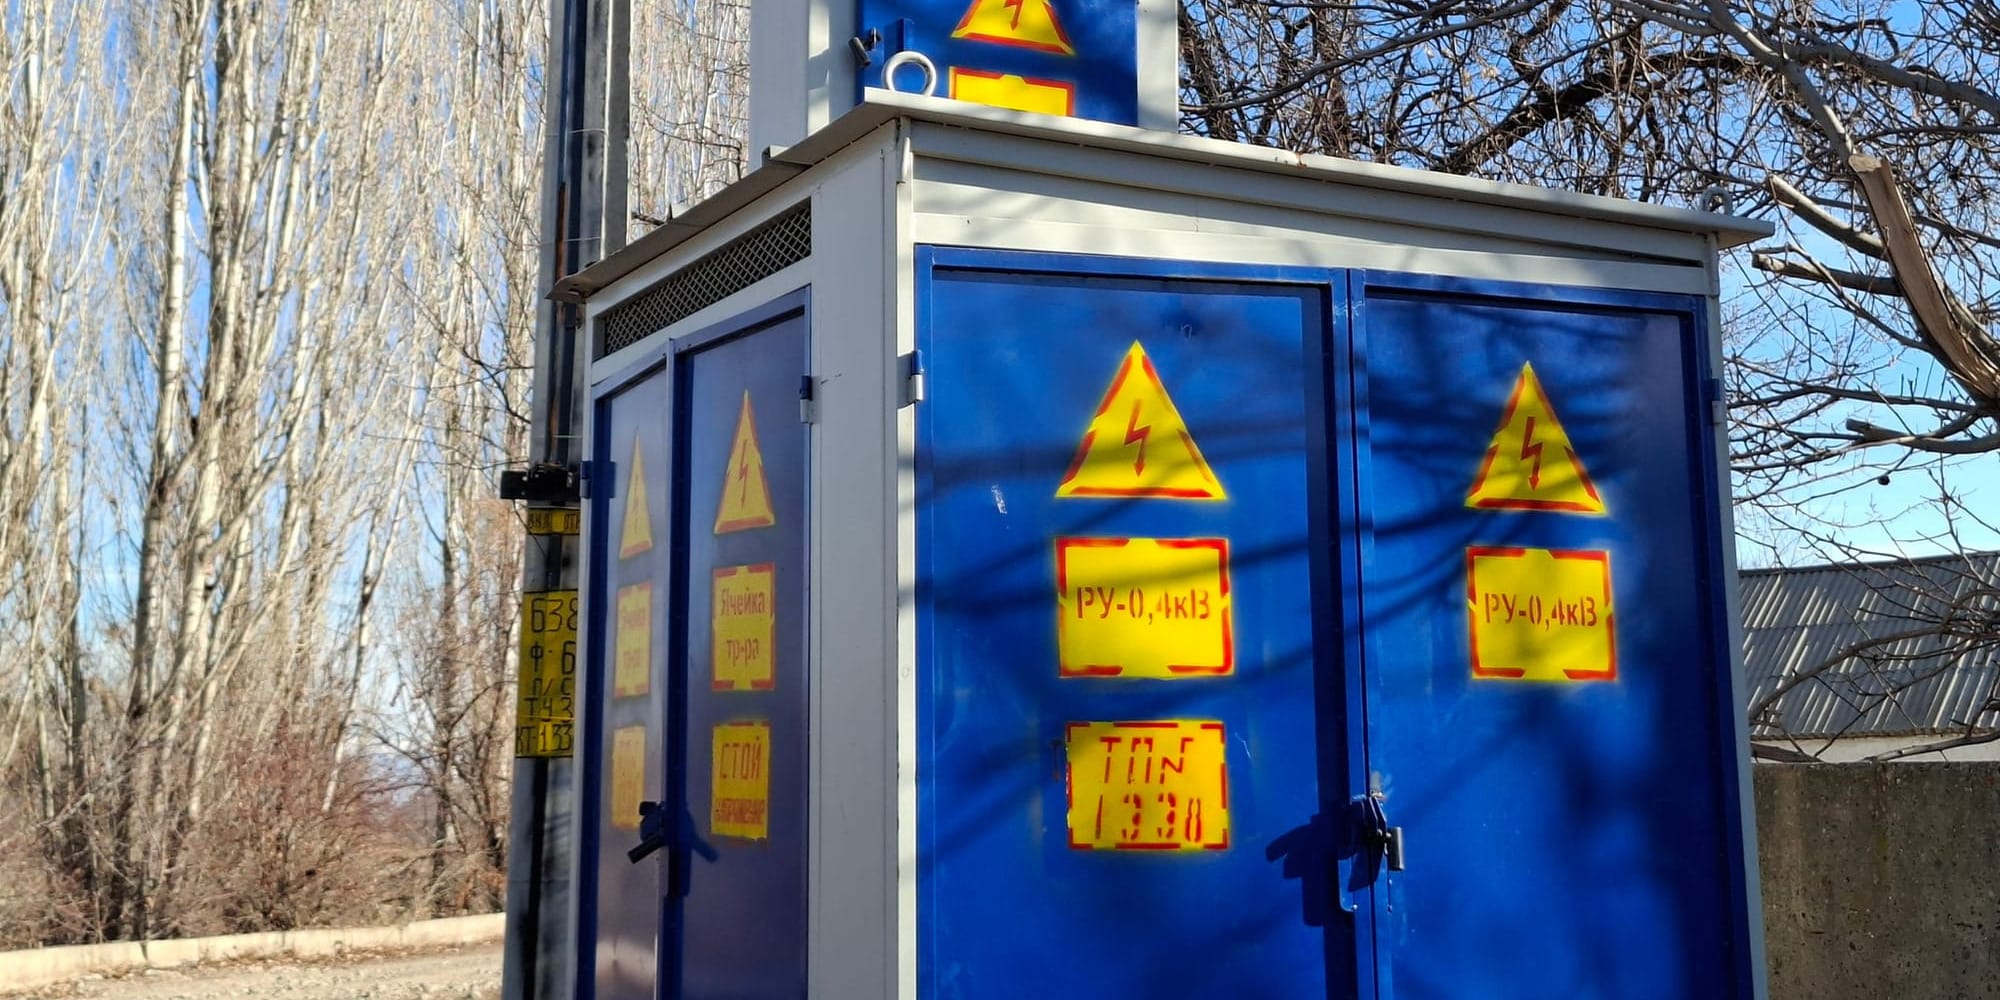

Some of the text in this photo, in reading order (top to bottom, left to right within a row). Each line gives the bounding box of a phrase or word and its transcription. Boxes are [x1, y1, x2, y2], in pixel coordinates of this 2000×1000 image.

[720, 586, 766, 617] Ячейка
[1076, 585, 1211, 625] РУ-0,4кВ
[1483, 591, 1598, 631] РУ-0,4кВ
[719, 735, 762, 781] СТОЙ
